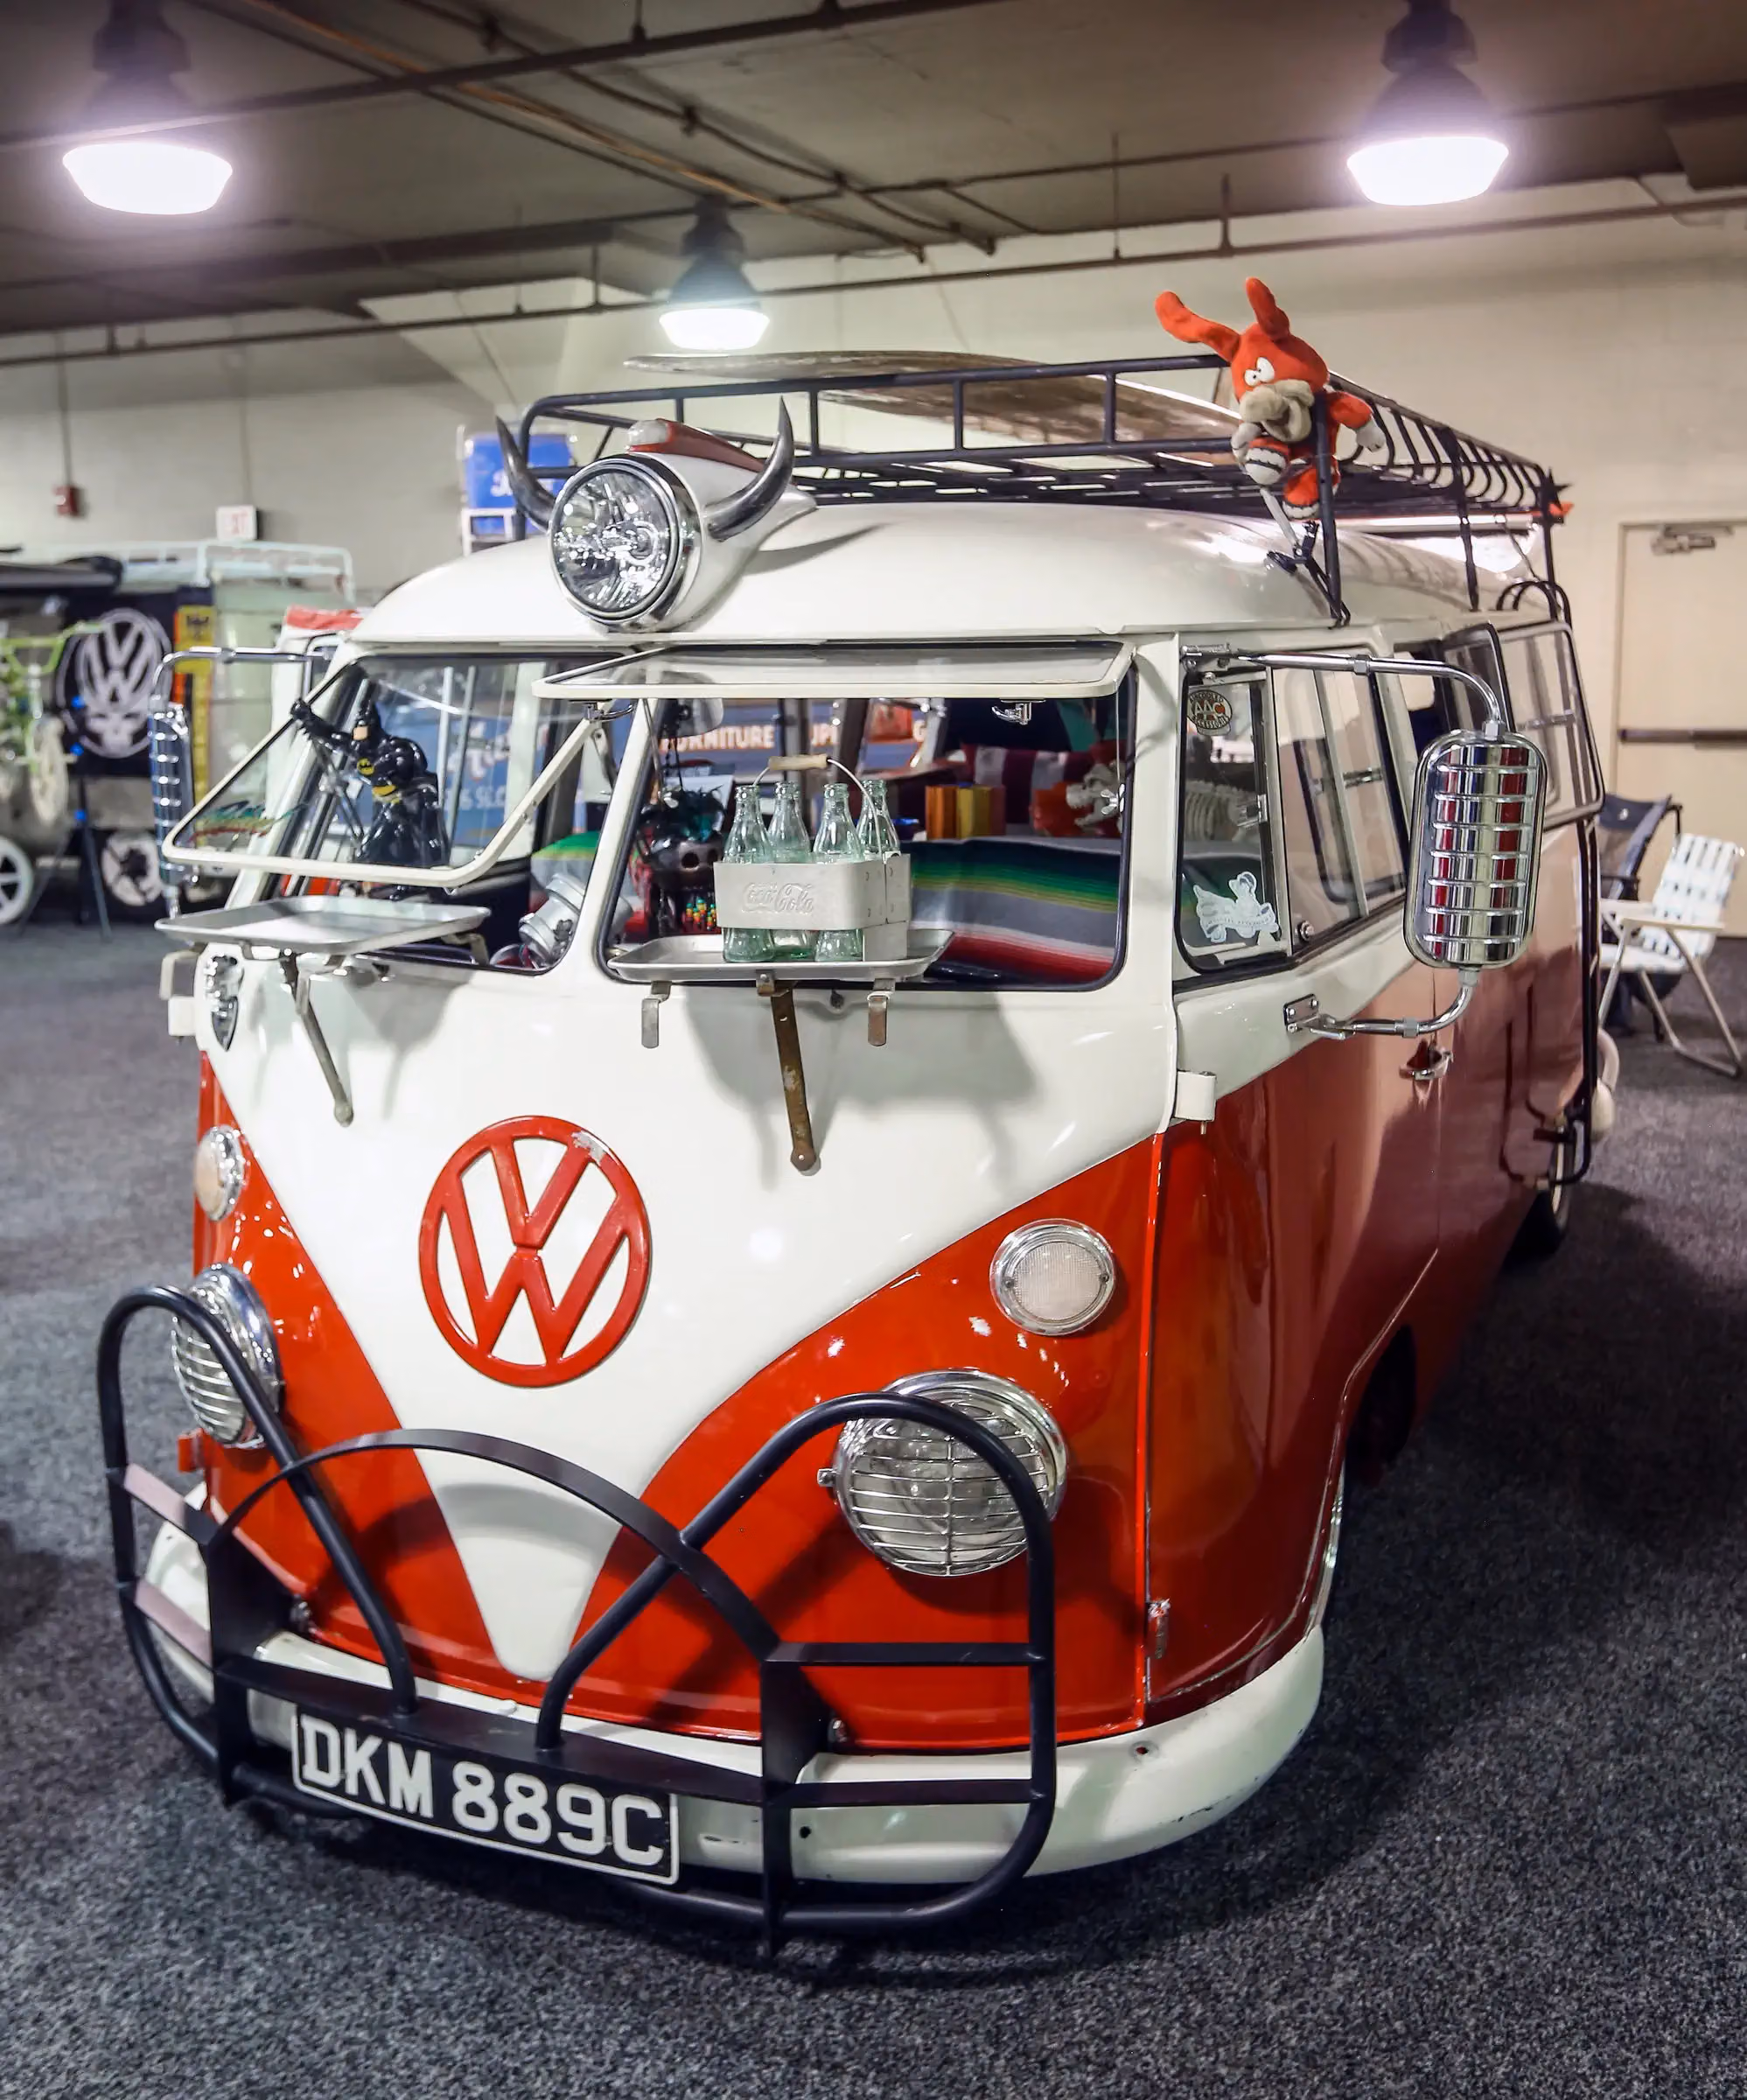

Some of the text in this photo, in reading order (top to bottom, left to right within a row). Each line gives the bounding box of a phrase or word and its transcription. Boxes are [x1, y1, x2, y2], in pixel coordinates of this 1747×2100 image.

[423, 1118, 649, 1382] VW
[301, 1714, 665, 1867] DKM 889C
